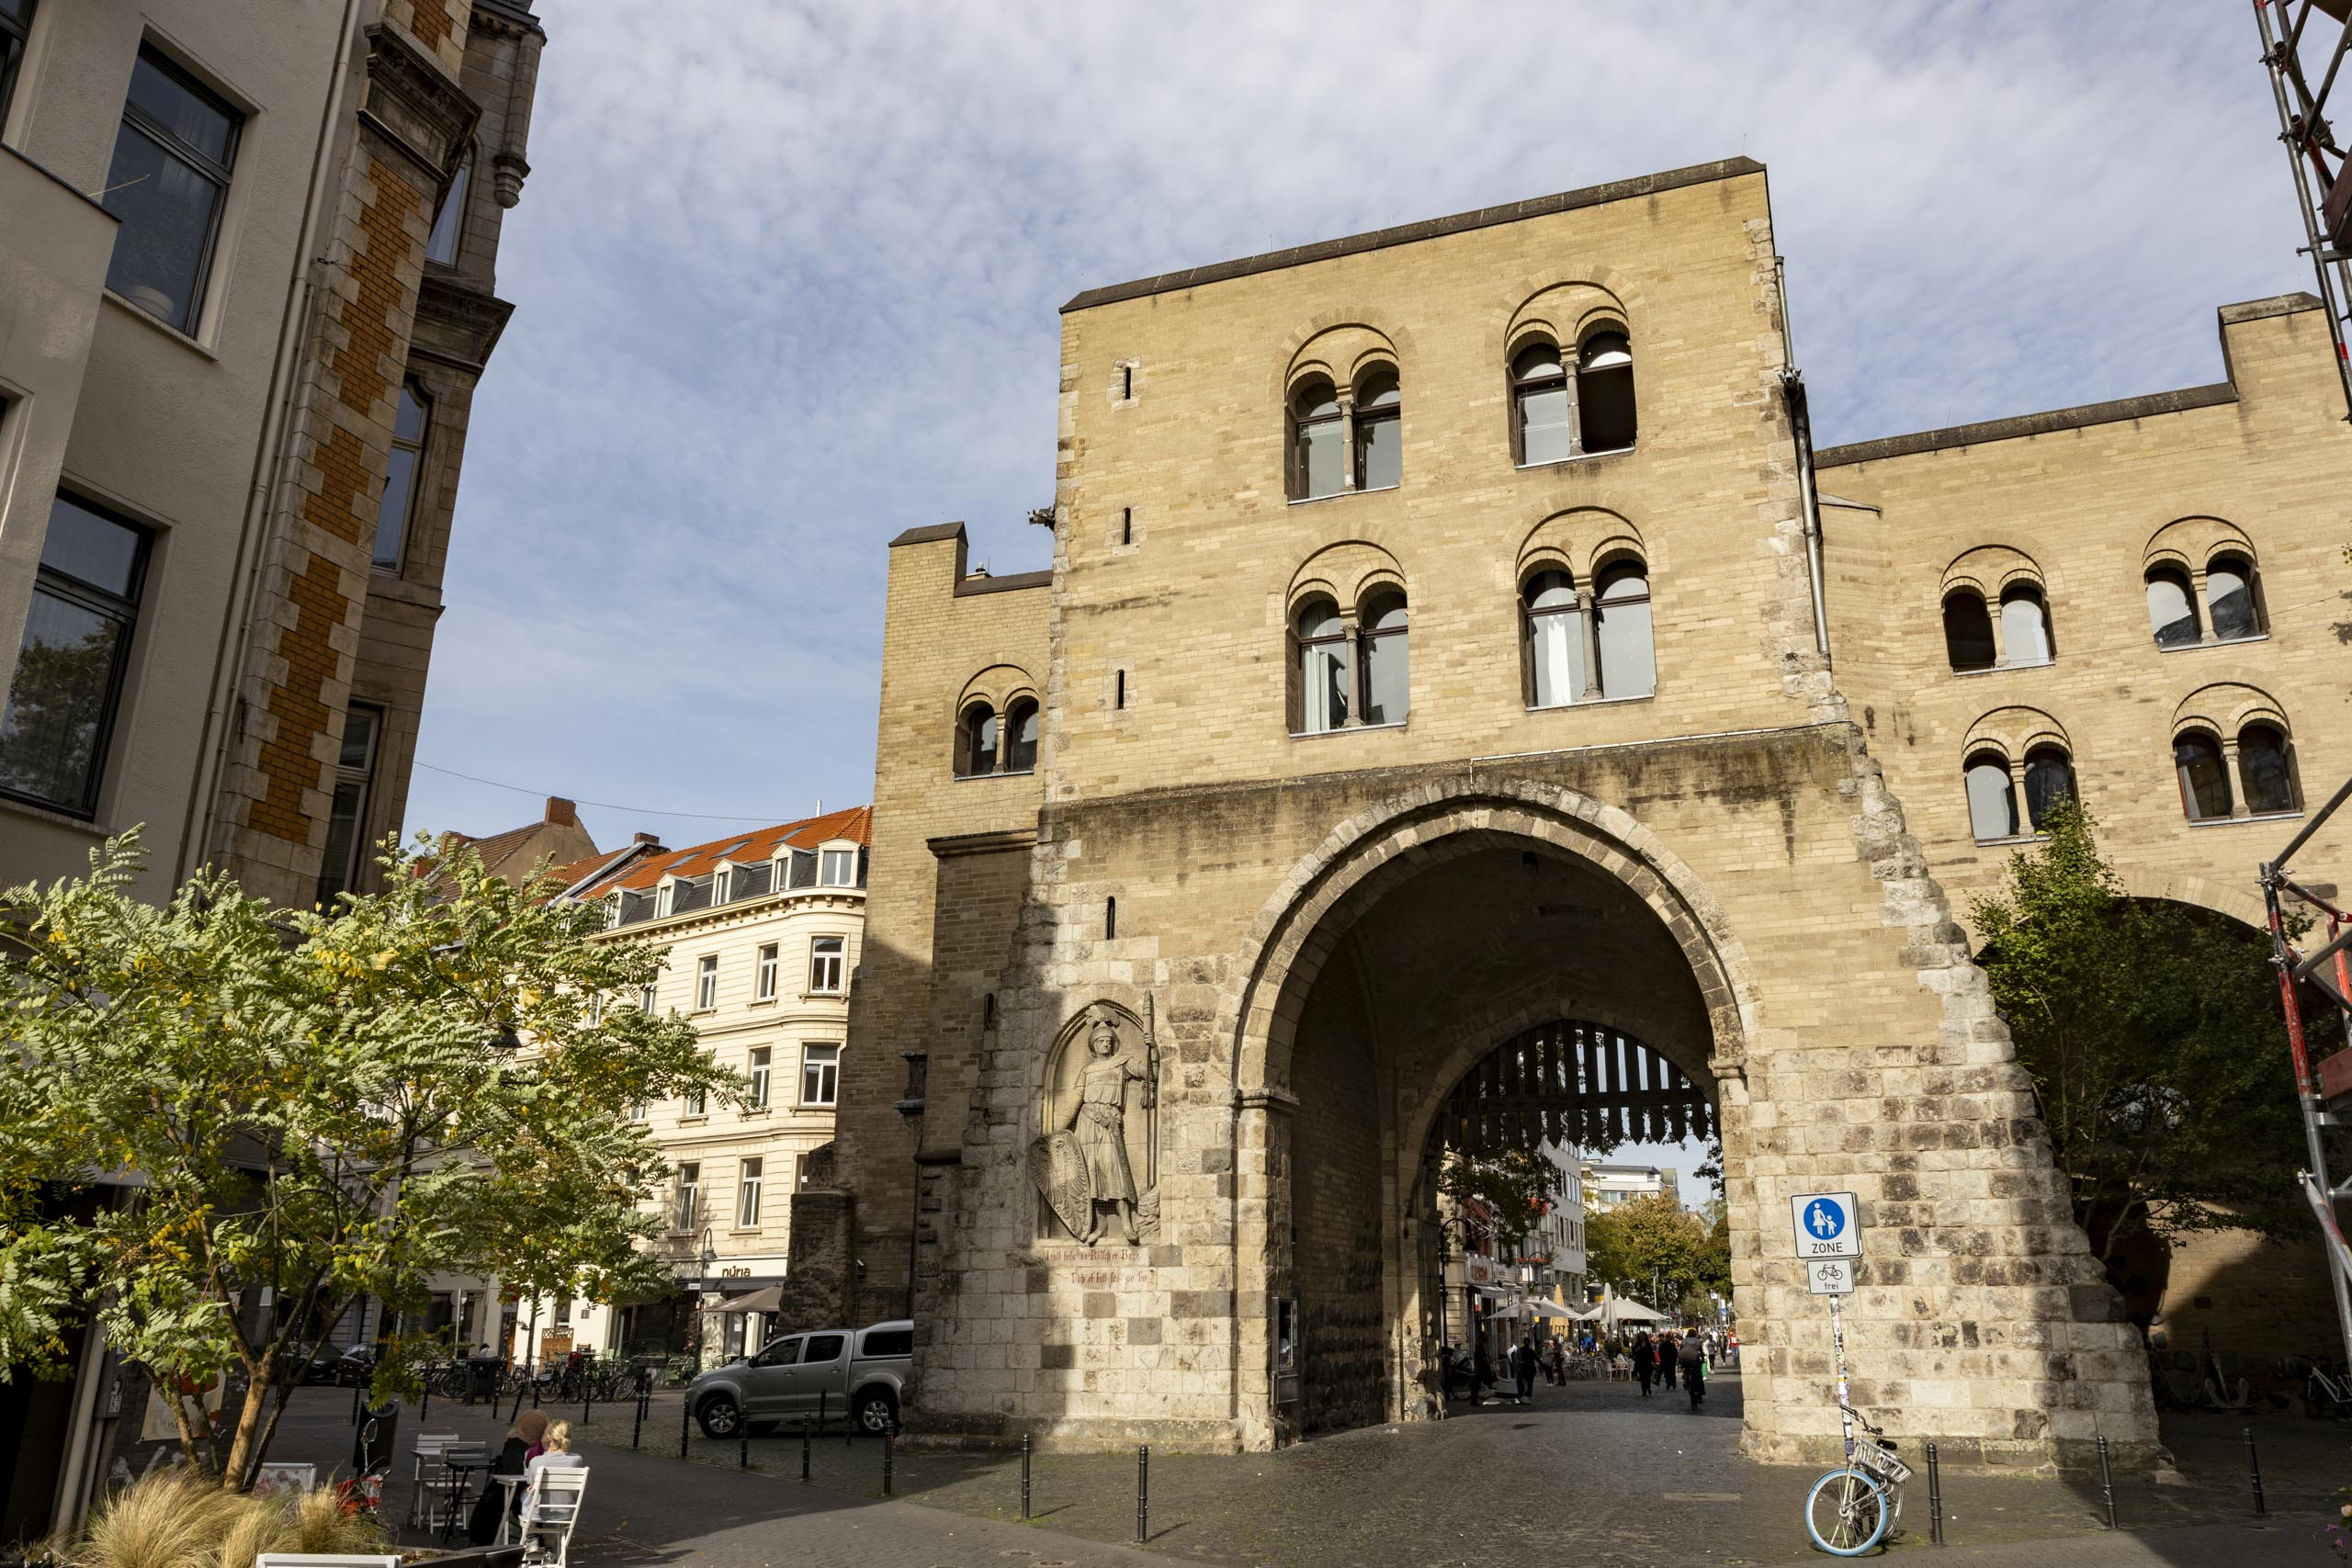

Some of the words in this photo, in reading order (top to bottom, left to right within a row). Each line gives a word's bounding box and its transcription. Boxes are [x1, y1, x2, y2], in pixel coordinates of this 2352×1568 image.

[1812, 1242, 1843, 1253] ZONE
[722, 1265, 751, 1278] núria
[1824, 1282, 1838, 1291] frei
